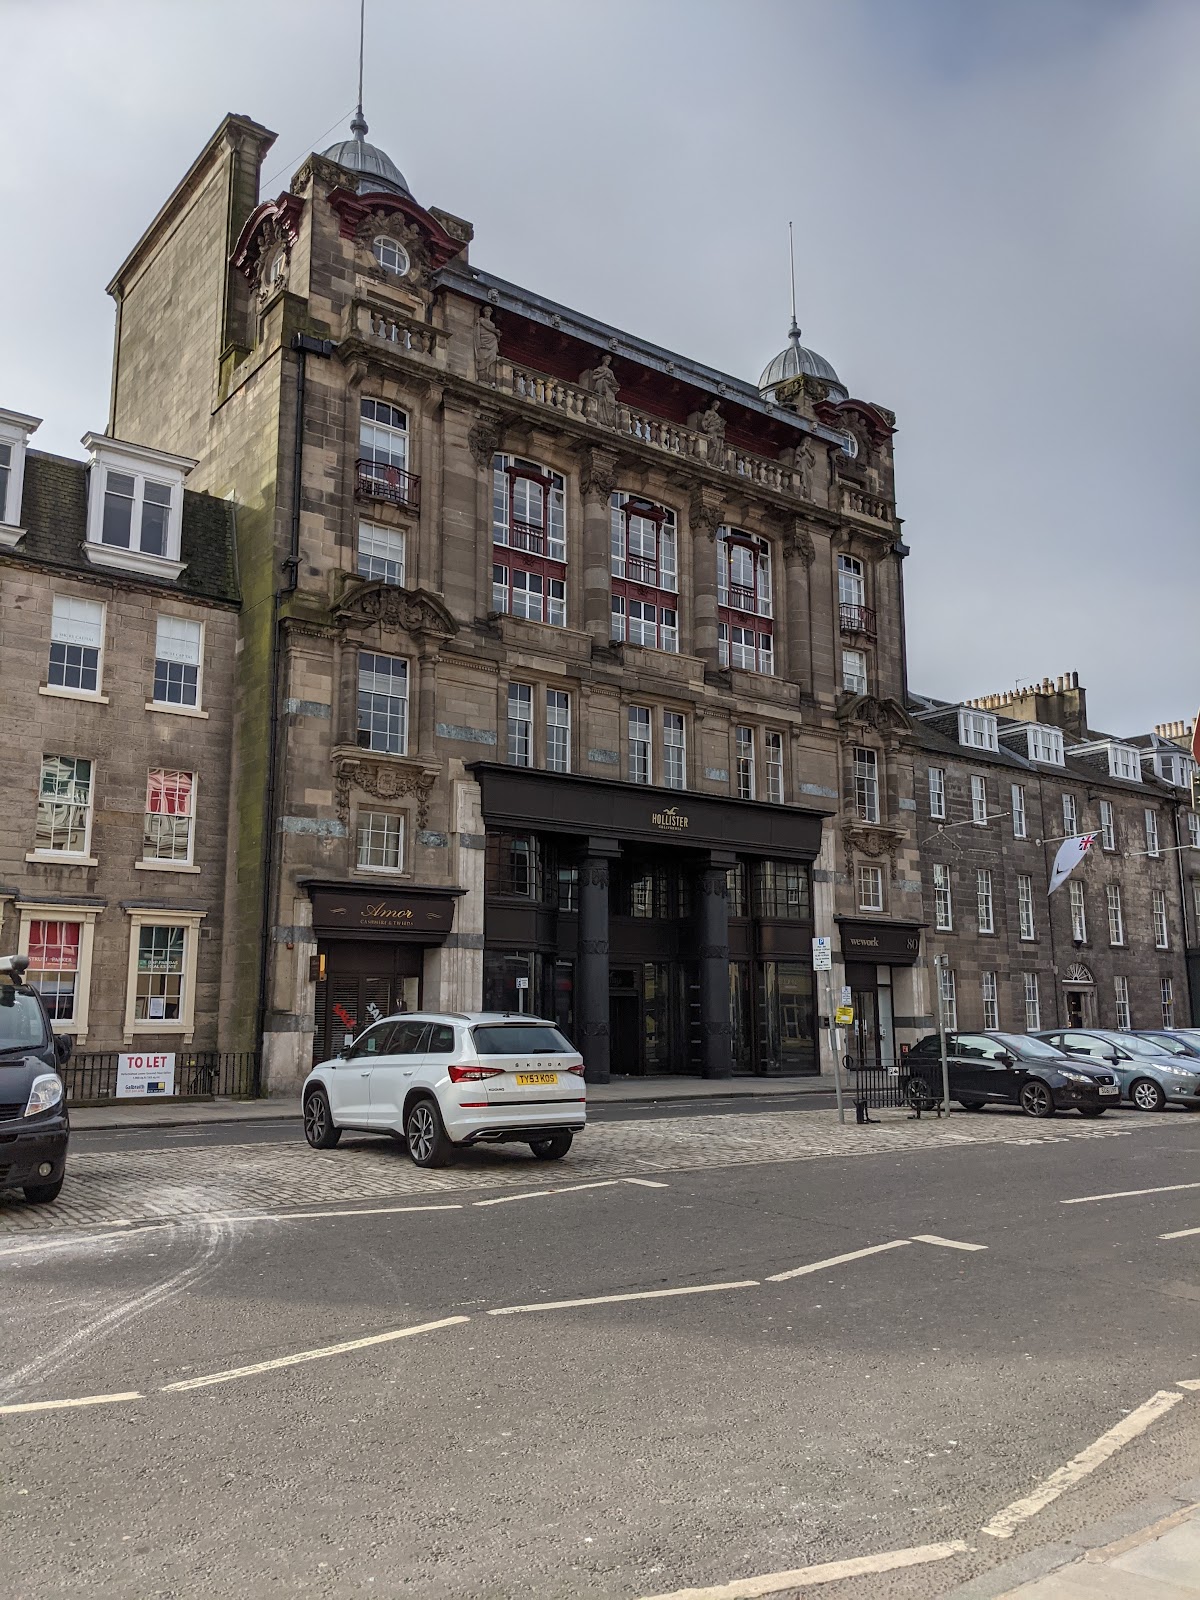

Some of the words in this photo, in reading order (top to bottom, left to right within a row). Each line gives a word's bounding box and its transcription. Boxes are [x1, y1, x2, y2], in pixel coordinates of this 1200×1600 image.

[652, 813, 689, 828] HOLLISTER
[361, 902, 414, 919] Amor
[850, 937, 879, 947] wework
[907, 938, 918, 950] 80
[366, 1002, 383, 1022] SAL
[127, 1057, 143, 1068] TO
[146, 1056, 168, 1068] LET
[519, 1074, 540, 1083] TY53
[540, 1074, 555, 1082] KOS
